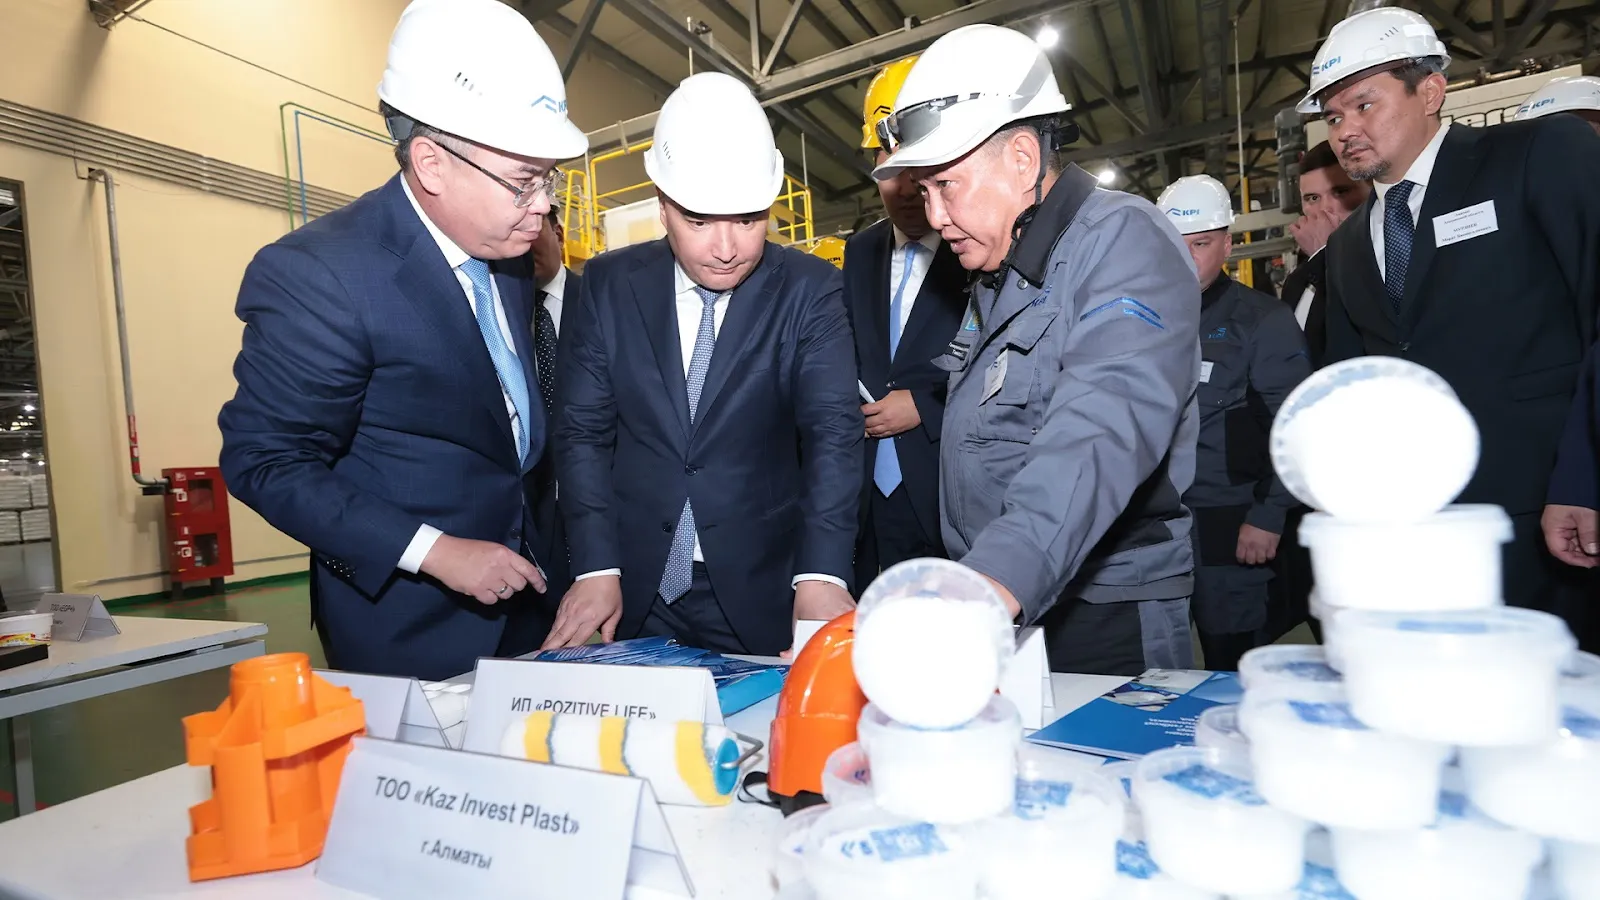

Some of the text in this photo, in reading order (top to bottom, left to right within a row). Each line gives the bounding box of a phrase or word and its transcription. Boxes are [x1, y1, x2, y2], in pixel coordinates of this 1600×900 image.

[1321, 55, 1342, 72] KPI
[1532, 97, 1556, 110] KPI
[1182, 209, 1200, 217] KPI
[510, 697, 532, 712] ИП
[535, 699, 610, 718] «POZITIVE
[374, 776, 580, 836] ТОО «Kaz Invest Plast»
[420, 836, 493, 870] г.Алматы
